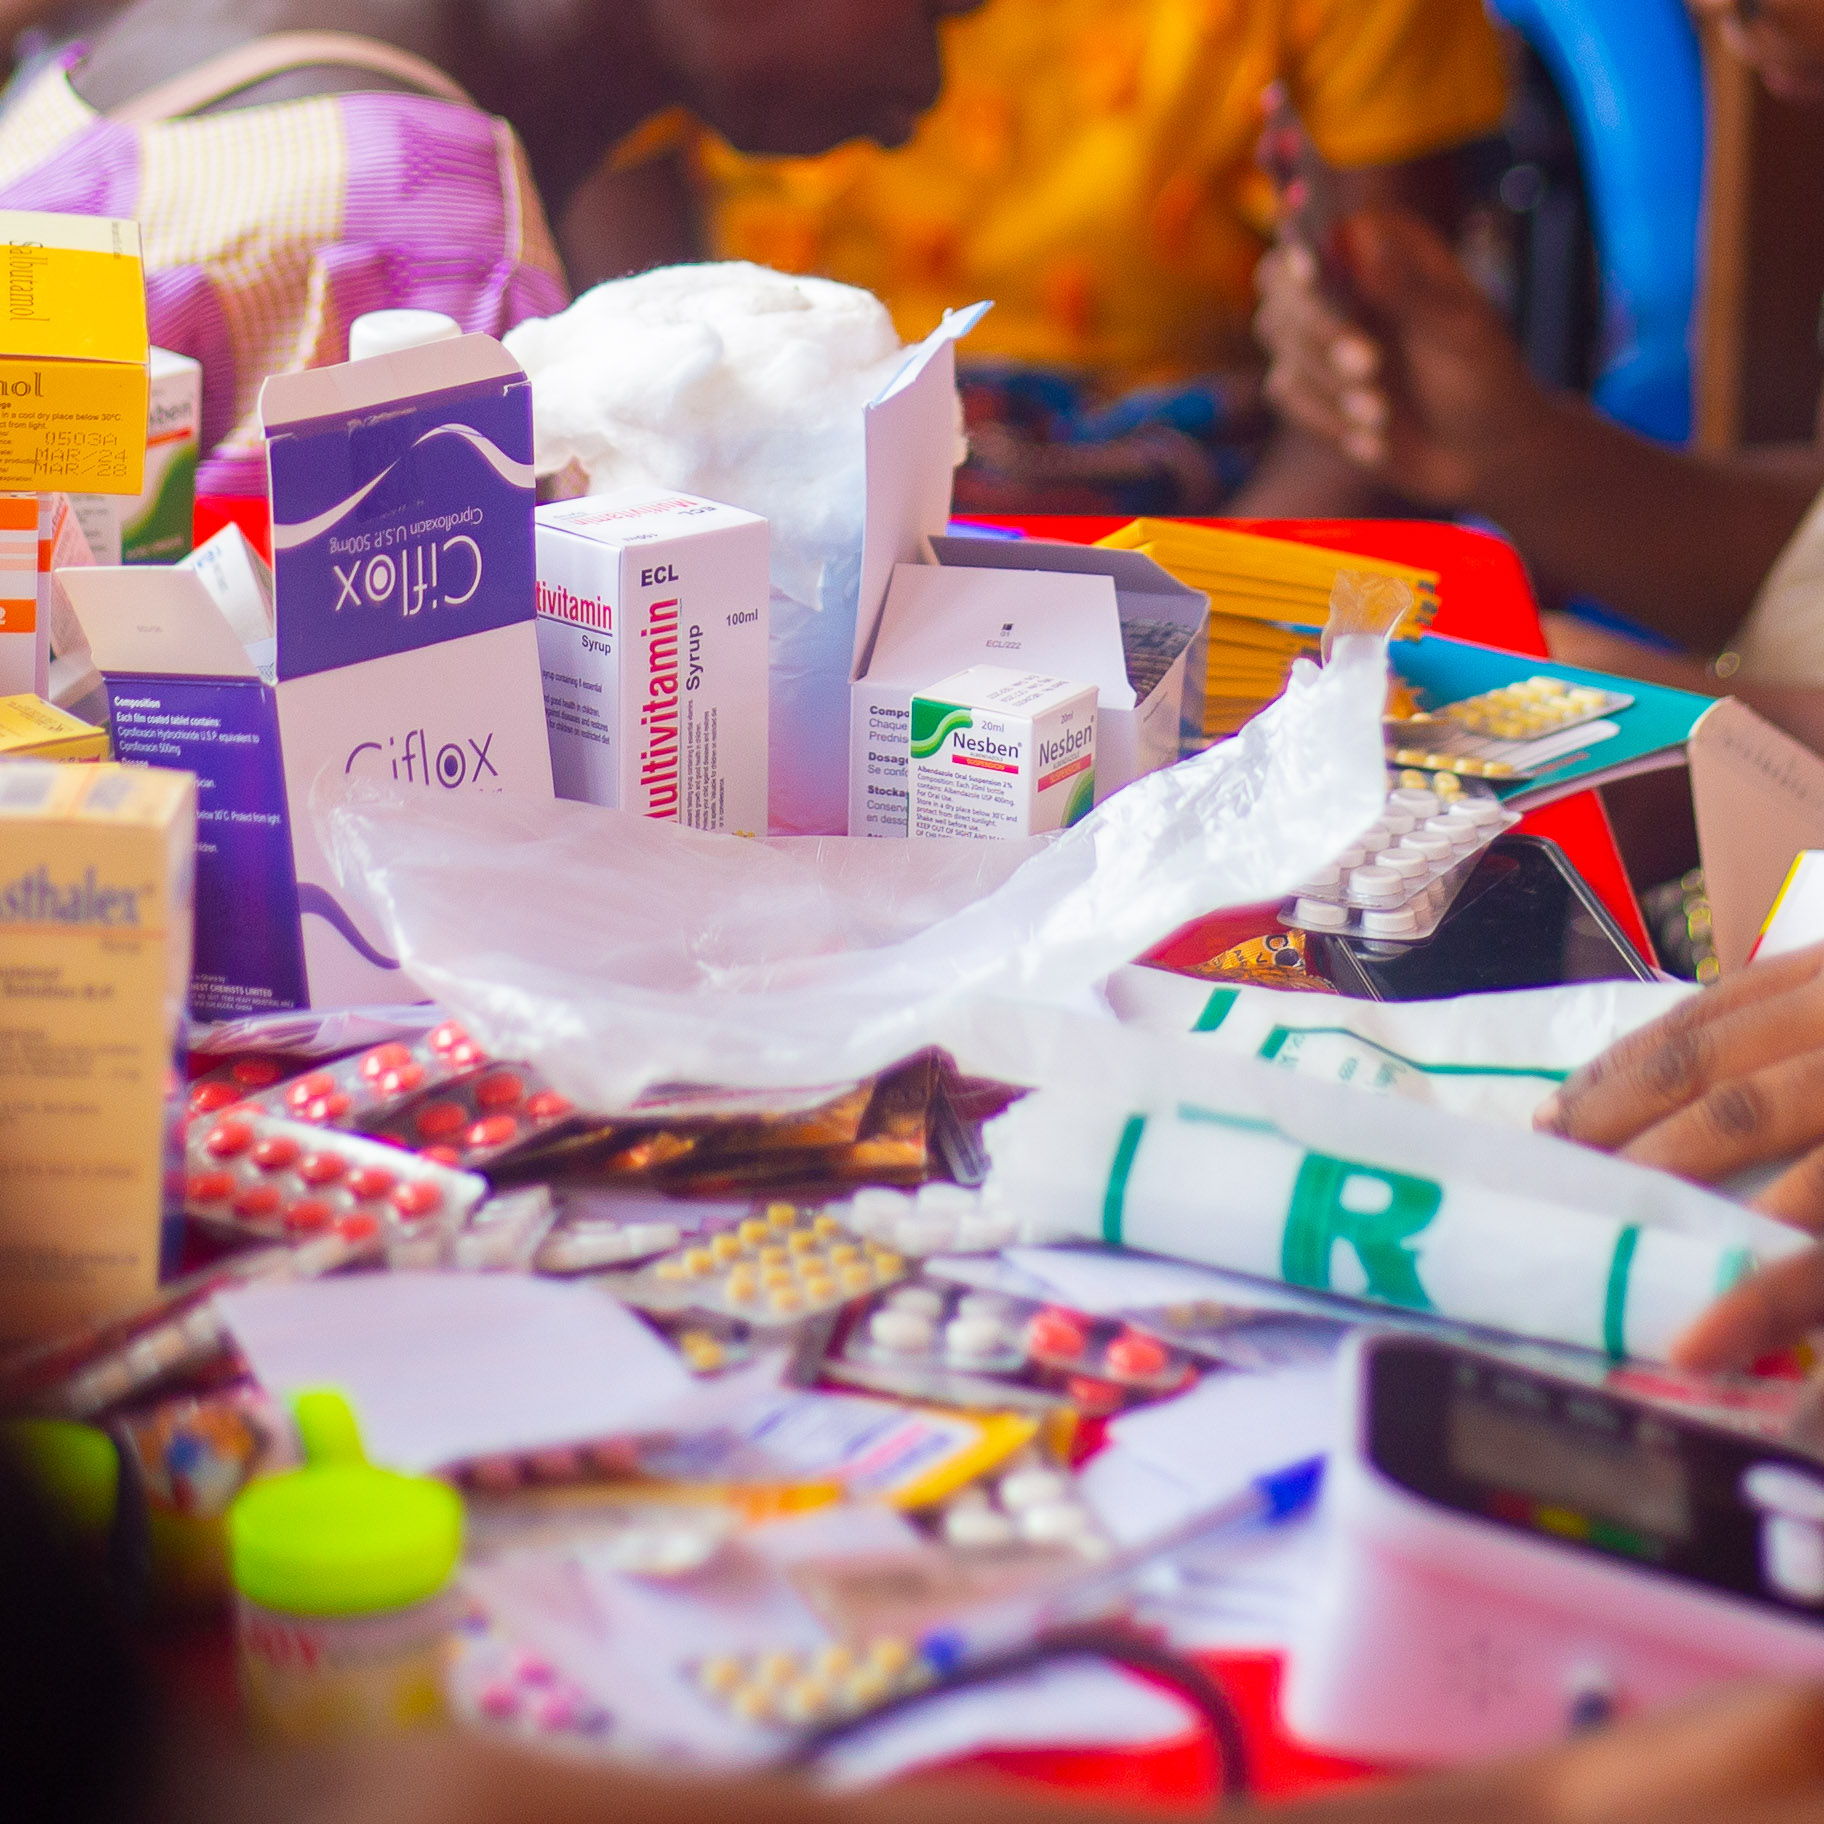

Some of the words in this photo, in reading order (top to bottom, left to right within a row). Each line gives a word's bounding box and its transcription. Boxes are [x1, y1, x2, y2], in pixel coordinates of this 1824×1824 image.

[10, 240, 50, 322] Salbutamol
[18, 411, 36, 419] cool
[37, 412, 51, 422] dry
[52, 413, 74, 422] place
[75, 413, 100, 422] below
[8, 421, 27, 429] from
[408, 505, 485, 539] Ciprofloxacin
[328, 532, 372, 555] 500mg
[332, 534, 483, 617] Ciflox
[640, 563, 680, 588] ECL
[536, 579, 613, 631] tivitamin
[725, 608, 759, 627] 100ml
[581, 635, 612, 656] Syrup
[685, 624, 704, 691] Syrup
[113, 695, 161, 709] Composition
[116, 712, 133, 722] Each
[133, 712, 146, 723] film
[146, 714, 170, 725] coated
[170, 714, 190, 726] tablet
[869, 718, 908, 732] Chaque
[1060, 711, 1074, 725] 20ml
[981, 720, 1005, 733] 20ml
[117, 726, 156, 738] Ciprofloxacin
[157, 728, 200, 741] Hydrochloride
[218, 732, 252, 744] equivalent
[119, 740, 158, 752] Ciprofloxacin
[159, 741, 182, 756] 500mg
[867, 764, 881, 775] Se
[917, 765, 953, 777] Albendazole
[954, 772, 968, 780] Oral
[968, 775, 1002, 787] Suspension
[917, 789, 926, 797] For
[927, 791, 940, 800] Oral
[944, 786, 980, 799] Albendazole
[981, 793, 993, 801] USP
[956, 780, 969, 789] Each
[986, 786, 1005, 795] bottle
[230, 811, 253, 823] Protect
[253, 812, 267, 823] from
[916, 806, 938, 816] protect
[938, 810, 953, 818] from
[953, 813, 971, 822] direct
[917, 797, 932, 806] Store
[945, 803, 954, 812] dry
[955, 806, 971, 815] place
[972, 807, 990, 817] below
[1006, 814, 1018, 823] and
[866, 814, 879, 823] en
[916, 813, 933, 823] Shake
[934, 817, 947, 825] well
[947, 819, 967, 829] before
[916, 822, 931, 830] KEEP
[931, 824, 945, 833] OUT
[954, 829, 973, 838] SIGHT
[245, 986, 273, 998] LIMITED
[1280, 1149, 1444, 1313] R
